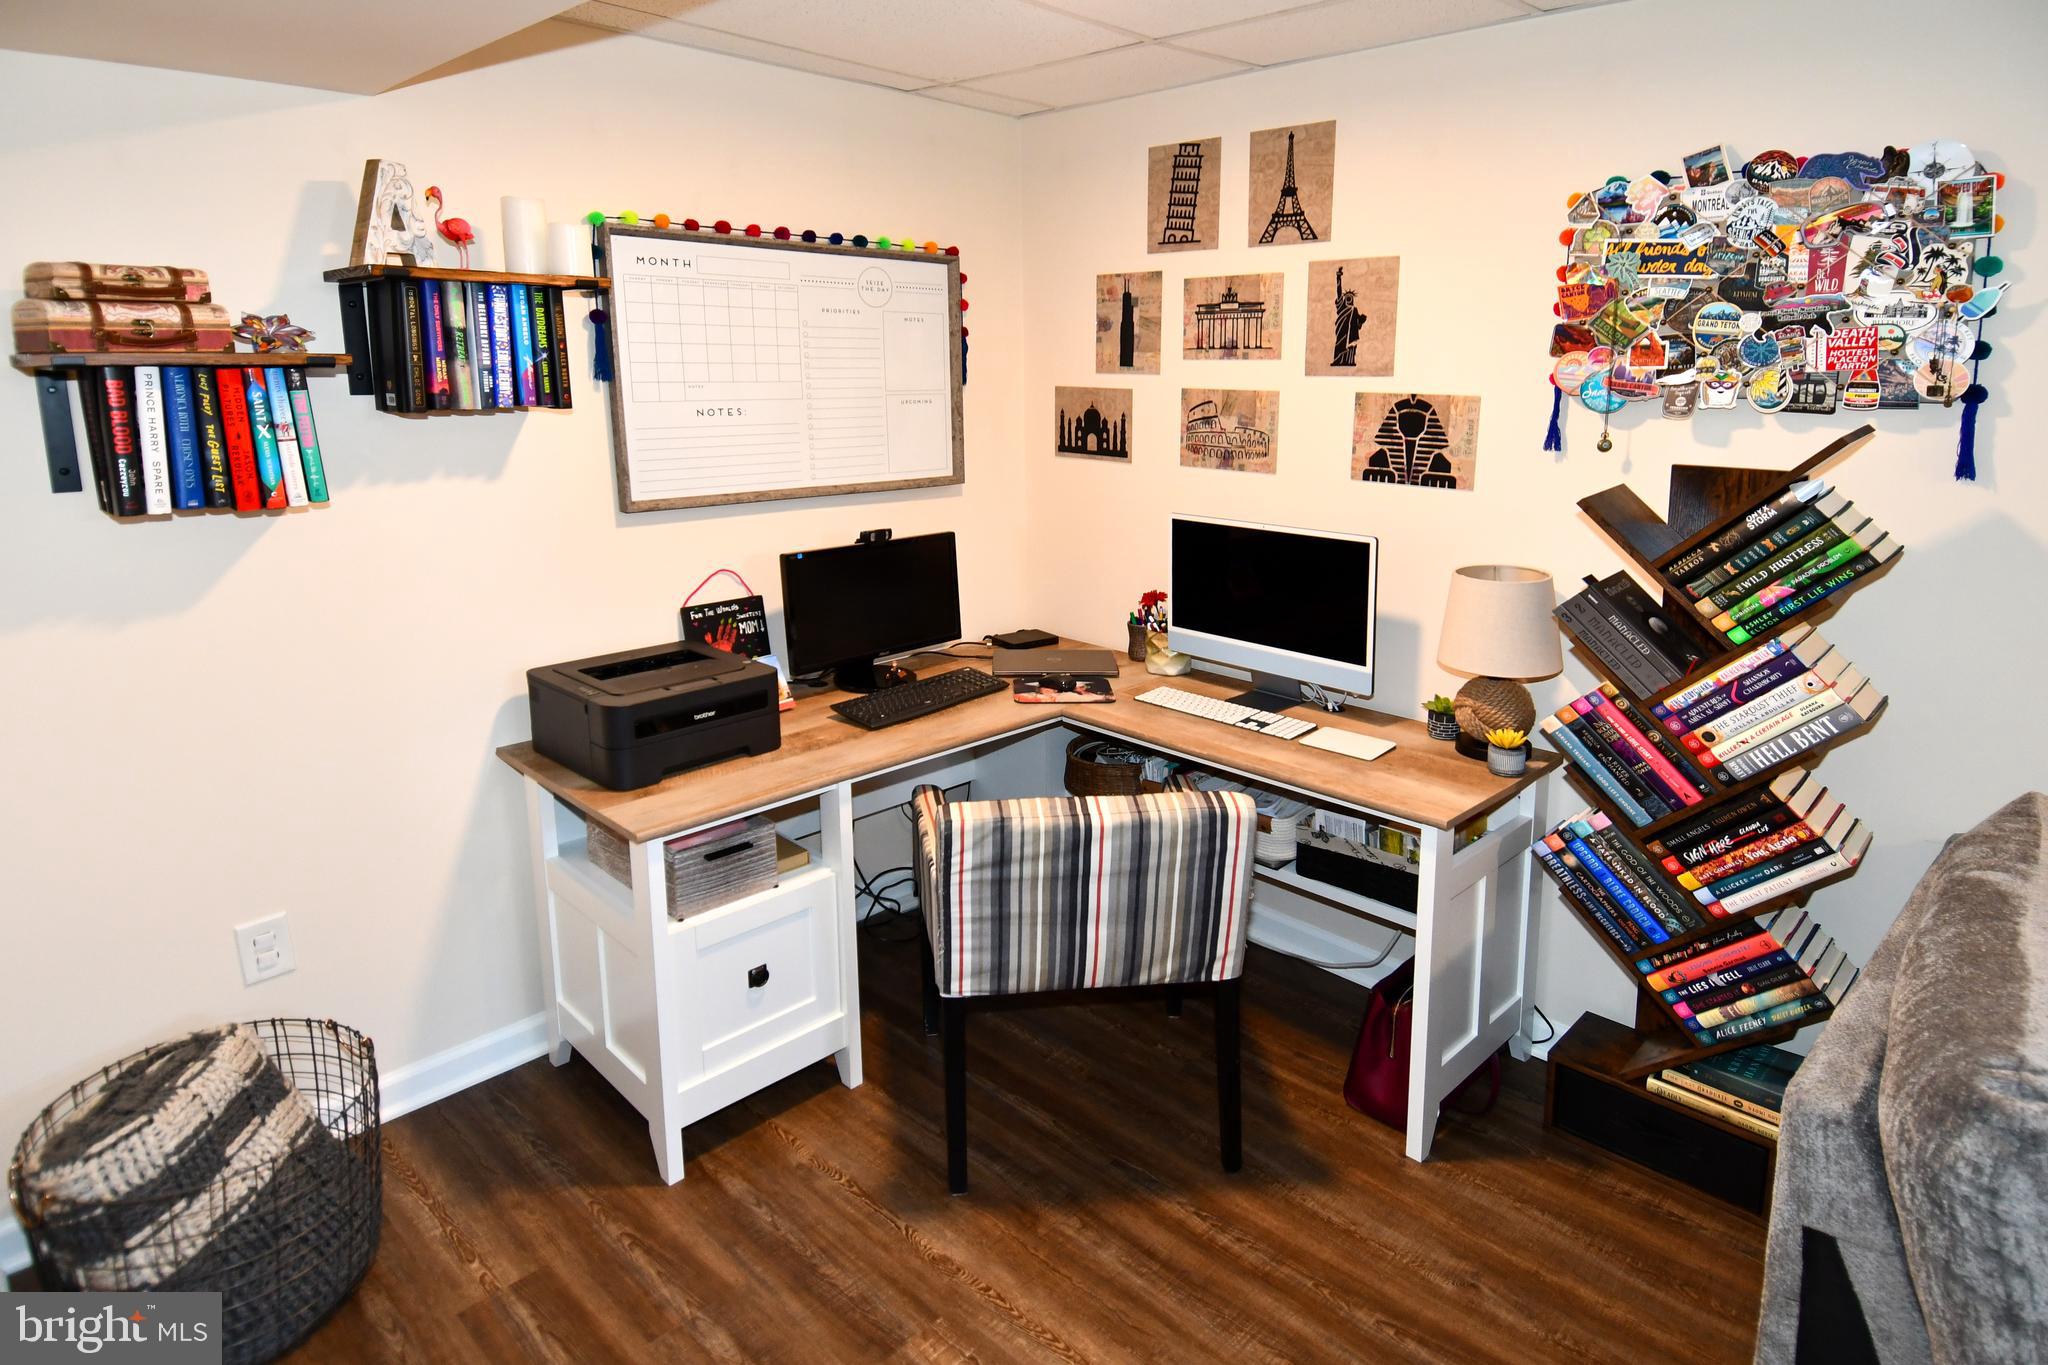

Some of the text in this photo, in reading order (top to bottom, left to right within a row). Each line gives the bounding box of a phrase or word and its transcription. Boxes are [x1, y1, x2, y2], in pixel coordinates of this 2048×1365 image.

[1692, 195, 1729, 213] MONTRÉAL
[1635, 240, 1689, 256] friends
[636, 256, 691, 268] MONTH
[1637, 259, 1676, 272] wder
[1817, 269, 1825, 279] BE
[1561, 285, 1585, 293] BRYCE
[518, 289, 529, 345] MEGAN ANGELO
[533, 291, 548, 348] THE DAYDREAMS
[1720, 321, 1740, 329] TETON
[433, 320, 443, 351] SURVIVORS
[476, 302, 491, 364] HELSINKI AFFAIR
[492, 292, 514, 394] FUNNY STORY EMILY HENRY
[1828, 337, 1875, 348] VALLEY
[1833, 328, 1875, 338] DEATH
[1828, 356, 1858, 364] PLACE
[1830, 348, 1875, 357] HOTTEST
[434, 356, 443, 382] MIRANDA
[440, 359, 448, 380] MEGAN
[1835, 362, 1868, 370] EARTH
[197, 372, 209, 391] LUCY
[105, 377, 133, 455] BAD BLOOD
[251, 390, 271, 440] SAINT X
[696, 408, 748, 417] NOTES:
[141, 372, 164, 494] PRINCE HARRY SPARE
[205, 423, 225, 493] THE GUEST LIST
[127, 468, 137, 486] John
[1744, 503, 1770, 524] ONYX
[1745, 506, 1778, 530] STORM
[1672, 553, 1705, 577] YARROS
[1740, 568, 1769, 591] WILD
[1768, 534, 1825, 574] HUNTRESS
[1789, 565, 1819, 586] PARADISE
[1816, 550, 1843, 571] PROBLEM
[1778, 566, 1855, 617] FIRST LIE WINS
[704, 608, 715, 617] THE
[1743, 609, 1774, 632] ASHLEY
[1587, 613, 1643, 672] MANACLED
[1607, 612, 1651, 658] MANACLED
[1741, 667, 1771, 687] SHANNON
[694, 710, 716, 720] brother
[1686, 694, 1723, 717] ADVENTURES
[1711, 683, 1799, 733] THE STARDUST THIEF
[1759, 696, 1796, 718] ABDULLAH
[1754, 718, 1782, 737] CERTAIN
[1779, 710, 1794, 723] AGE
[1625, 734, 1653, 762] LOVE STORY
[1716, 739, 1743, 759] KILLERS
[1751, 733, 1798, 771] HELL
[1792, 714, 1838, 751] BENT
[1597, 751, 1630, 788] ENCHANTED
[1611, 759, 1630, 779] RIVER
[1665, 800, 1758, 847] SMALL ANGELS LAUREN OWEN
[1738, 820, 1761, 835] CLAUDIA
[1756, 823, 1770, 834] LUX
[1682, 833, 1736, 866] SIGN HERE
[1767, 832, 1797, 852] Again
[1542, 851, 1587, 901] BREATHLESS
[1571, 839, 1602, 873] UPGRADE
[1602, 875, 1626, 901] BLAKE
[1622, 896, 1652, 929] CROUCH
[1611, 837, 1622, 850] THE
[1619, 846, 1639, 868] GOD
[1635, 864, 1647, 877] OF
[1654, 884, 1682, 916] WOODS
[1719, 876, 1749, 893] FLICKER
[1763, 861, 1784, 875] DARK
[1575, 869, 1618, 918] CARTOGRAPHERS
[1596, 886, 1606, 897] THE
[1611, 859, 1635, 886] INKED
[1632, 883, 1644, 895] IN
[1642, 893, 1666, 920] BLOOD
[1724, 896, 1740, 910] THE
[1762, 875, 1793, 894] PATIENT
[1625, 918, 1640, 935] PENG
[1722, 954, 1747, 967] Garmus
[1677, 988, 1689, 997] THE
[1687, 979, 1709, 994] LIES
[1719, 968, 1743, 983] TELL
[1714, 1016, 1767, 1039] ALICE FEENEY
